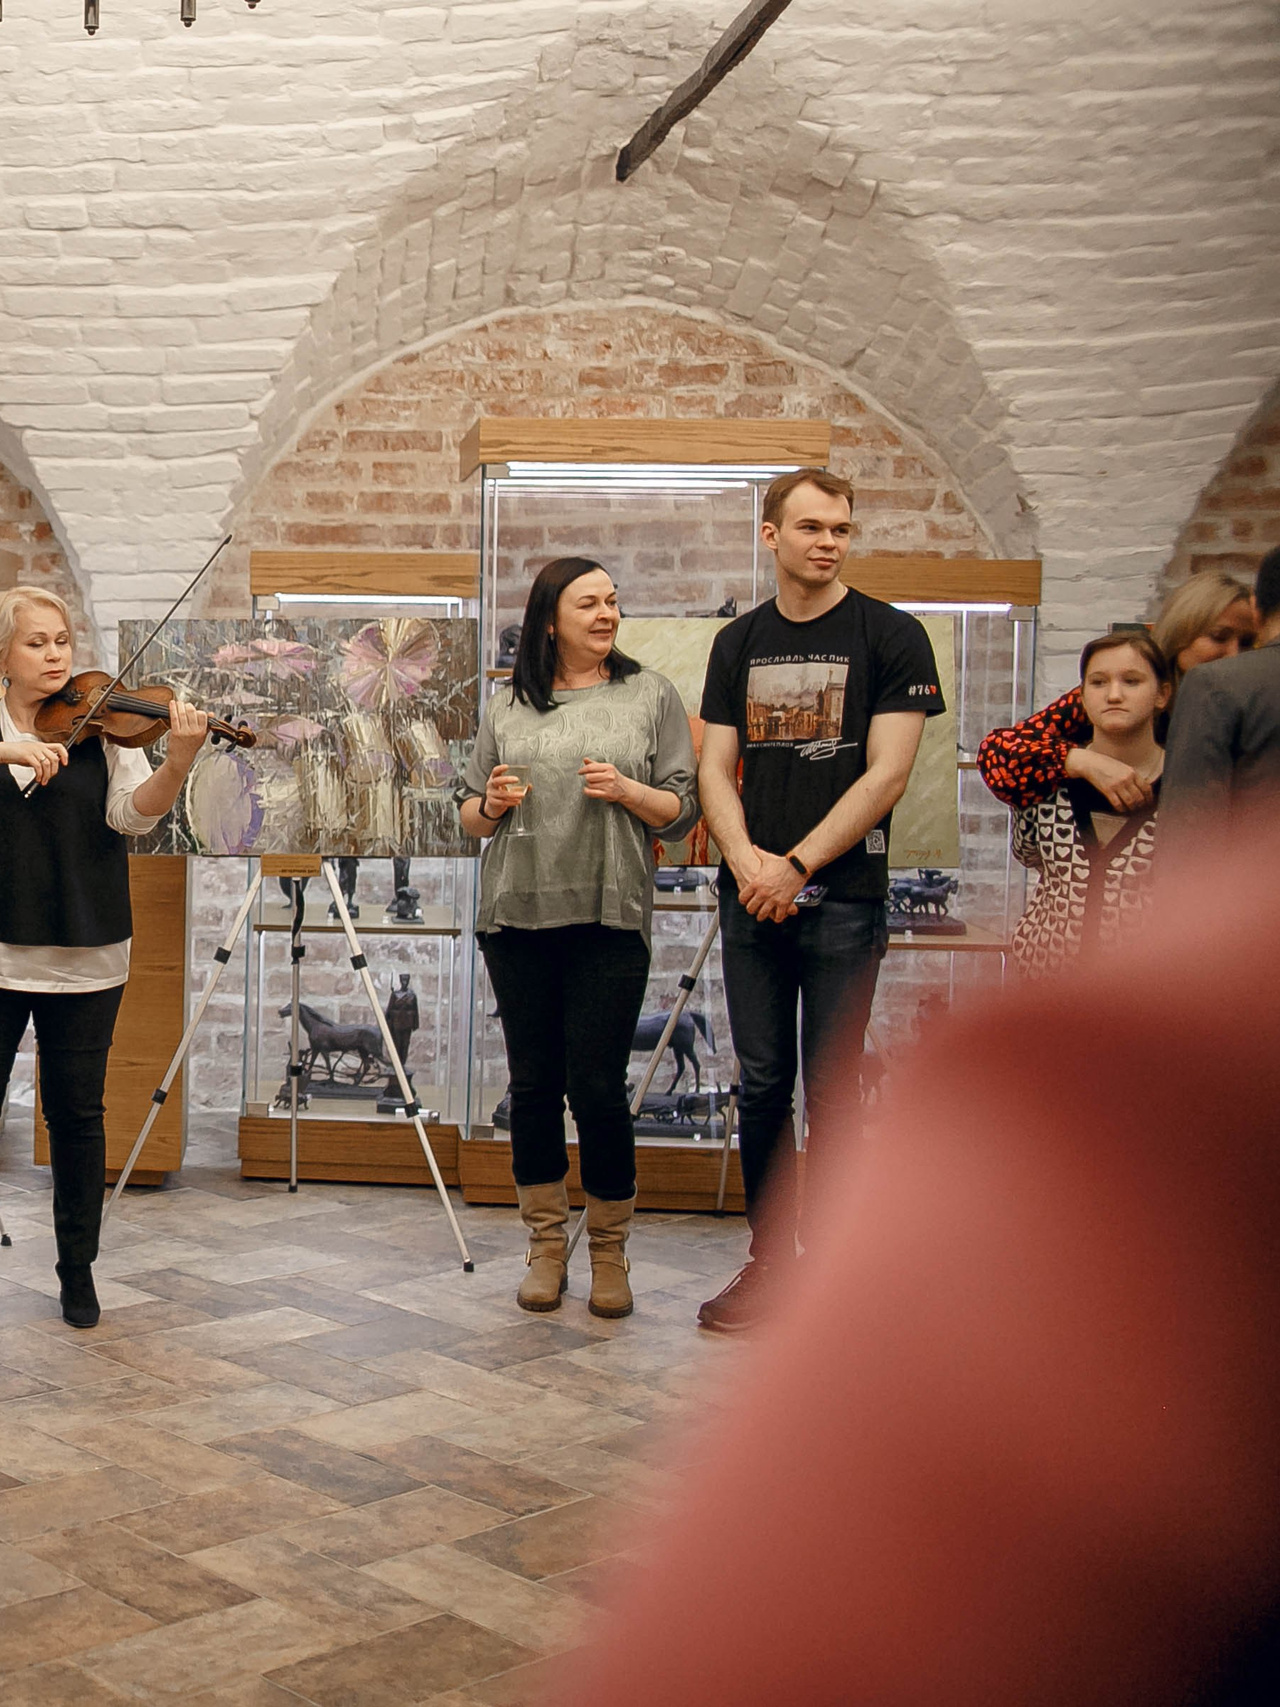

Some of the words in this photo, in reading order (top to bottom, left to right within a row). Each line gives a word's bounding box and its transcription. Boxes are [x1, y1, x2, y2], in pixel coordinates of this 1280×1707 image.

[807, 653, 827, 661] ЧАС
[828, 654, 850, 663] ПИК
[908, 684, 931, 697] #76
